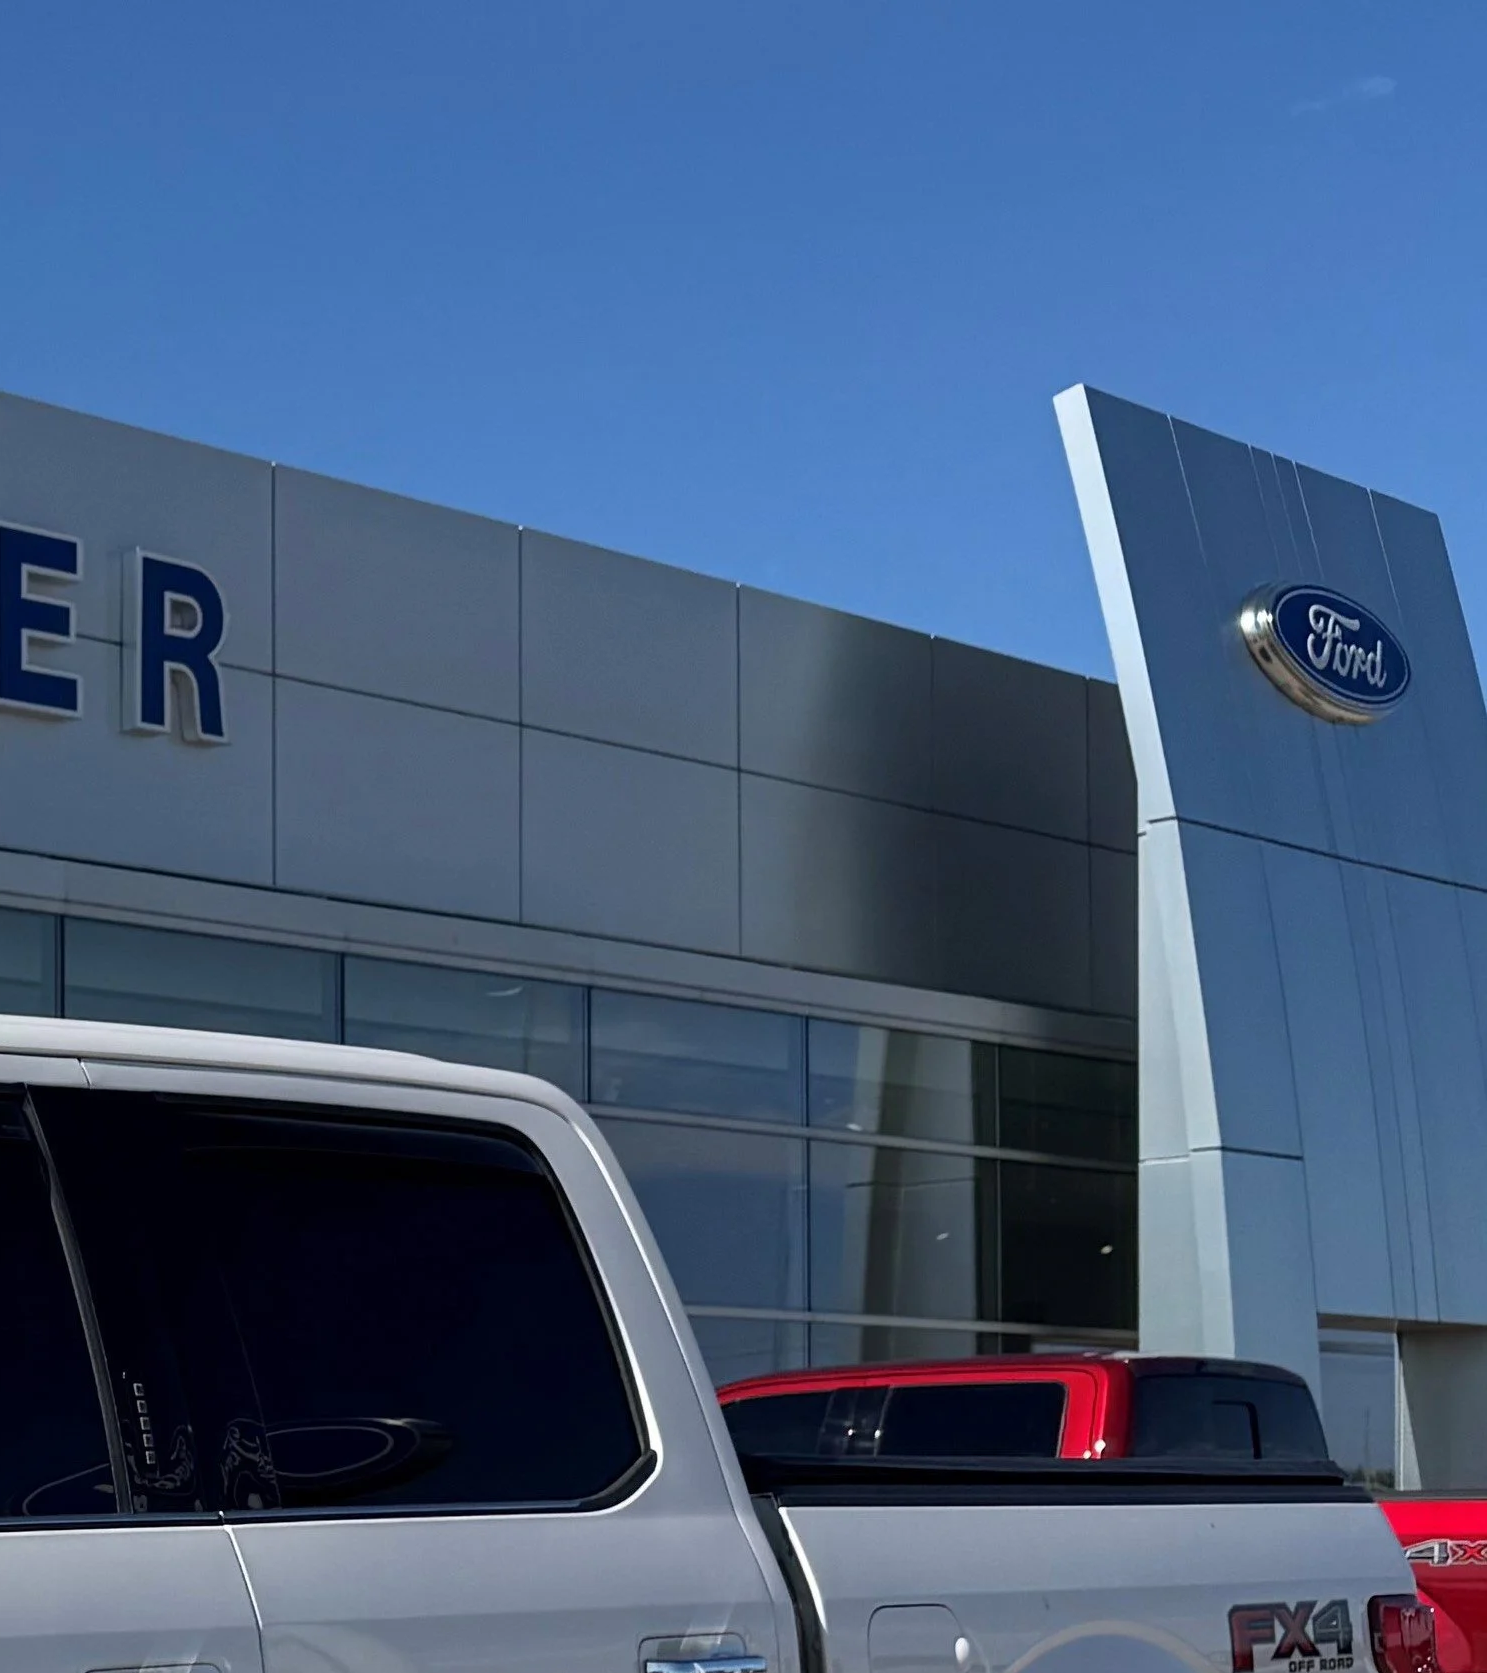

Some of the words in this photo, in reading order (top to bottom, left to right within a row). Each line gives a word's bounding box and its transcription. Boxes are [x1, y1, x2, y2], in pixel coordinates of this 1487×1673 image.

[1306, 603, 1388, 688] Ford
[1228, 1598, 1354, 1673] FX4
[1288, 1659, 1315, 1673] OFF
[1319, 1656, 1354, 1671] ROAD
